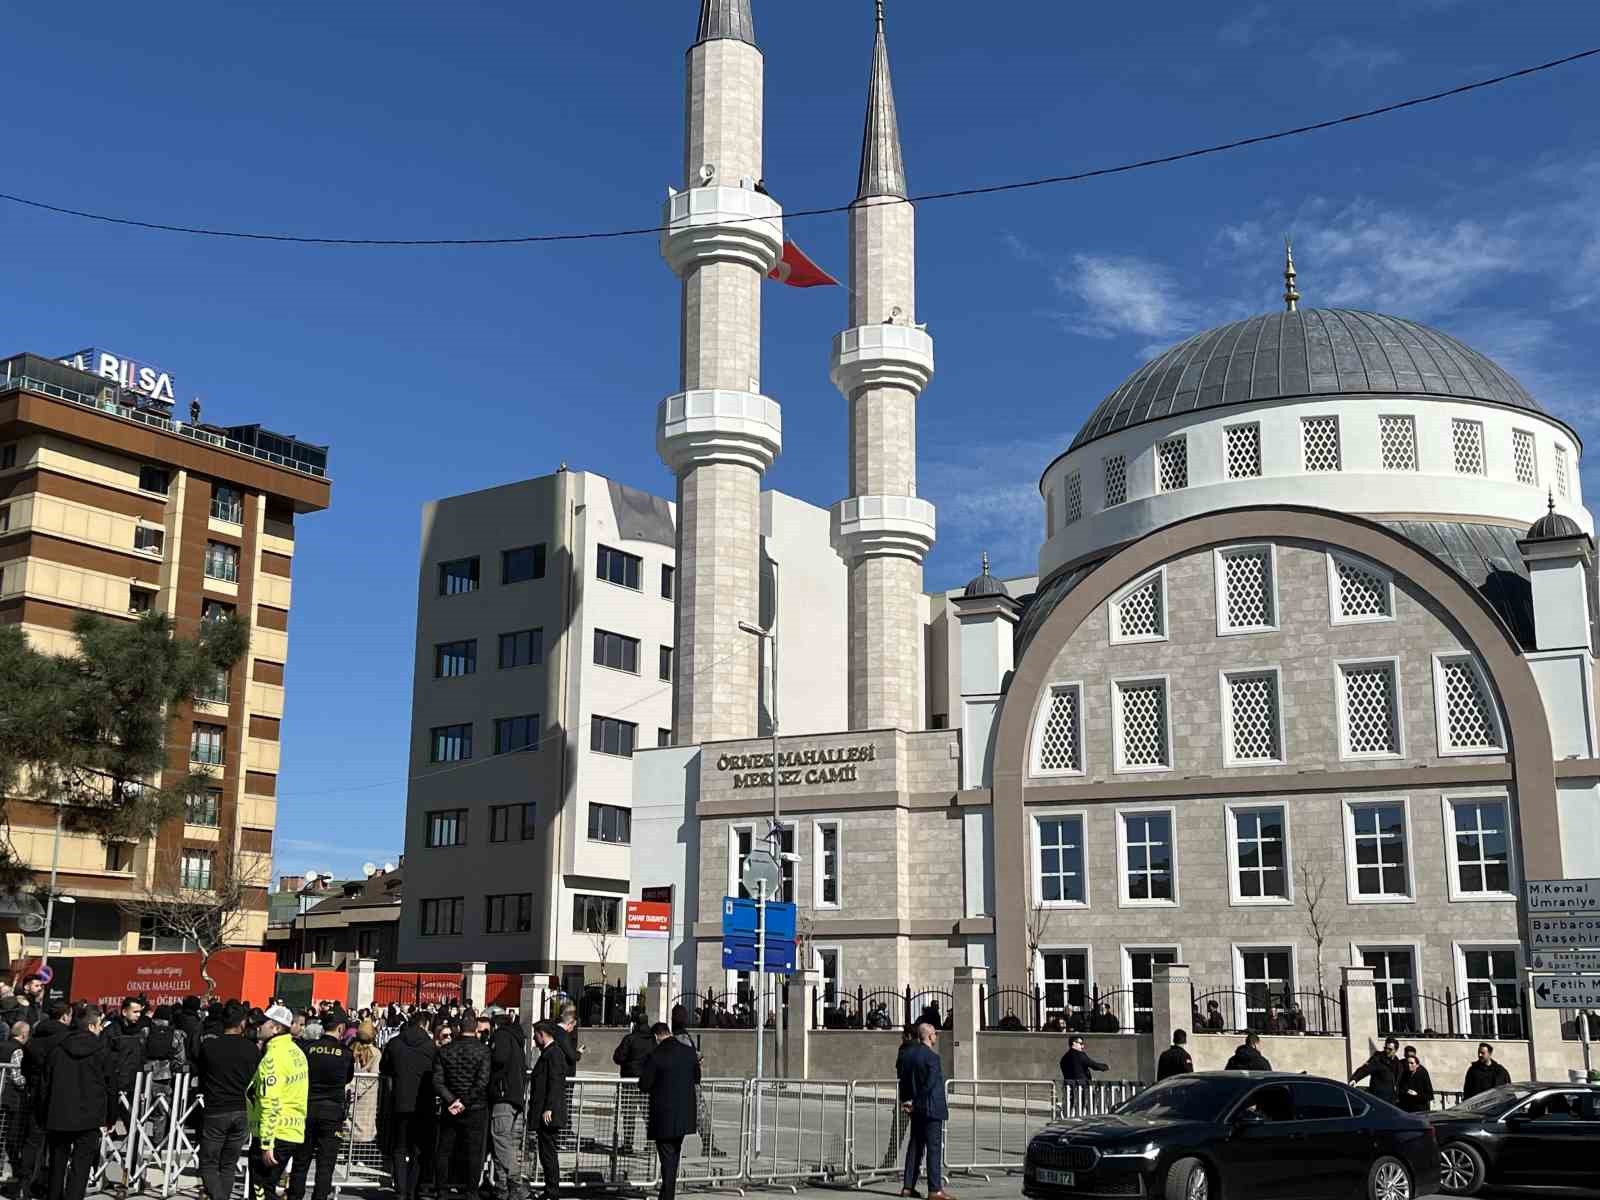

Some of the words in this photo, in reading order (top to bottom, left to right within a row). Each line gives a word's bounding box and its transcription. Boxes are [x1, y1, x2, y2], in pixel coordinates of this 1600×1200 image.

[777, 744, 877, 767] MAHALLESİ
[805, 764, 857, 785] CAMİİ
[127, 980, 151, 991] ÖRNEK
